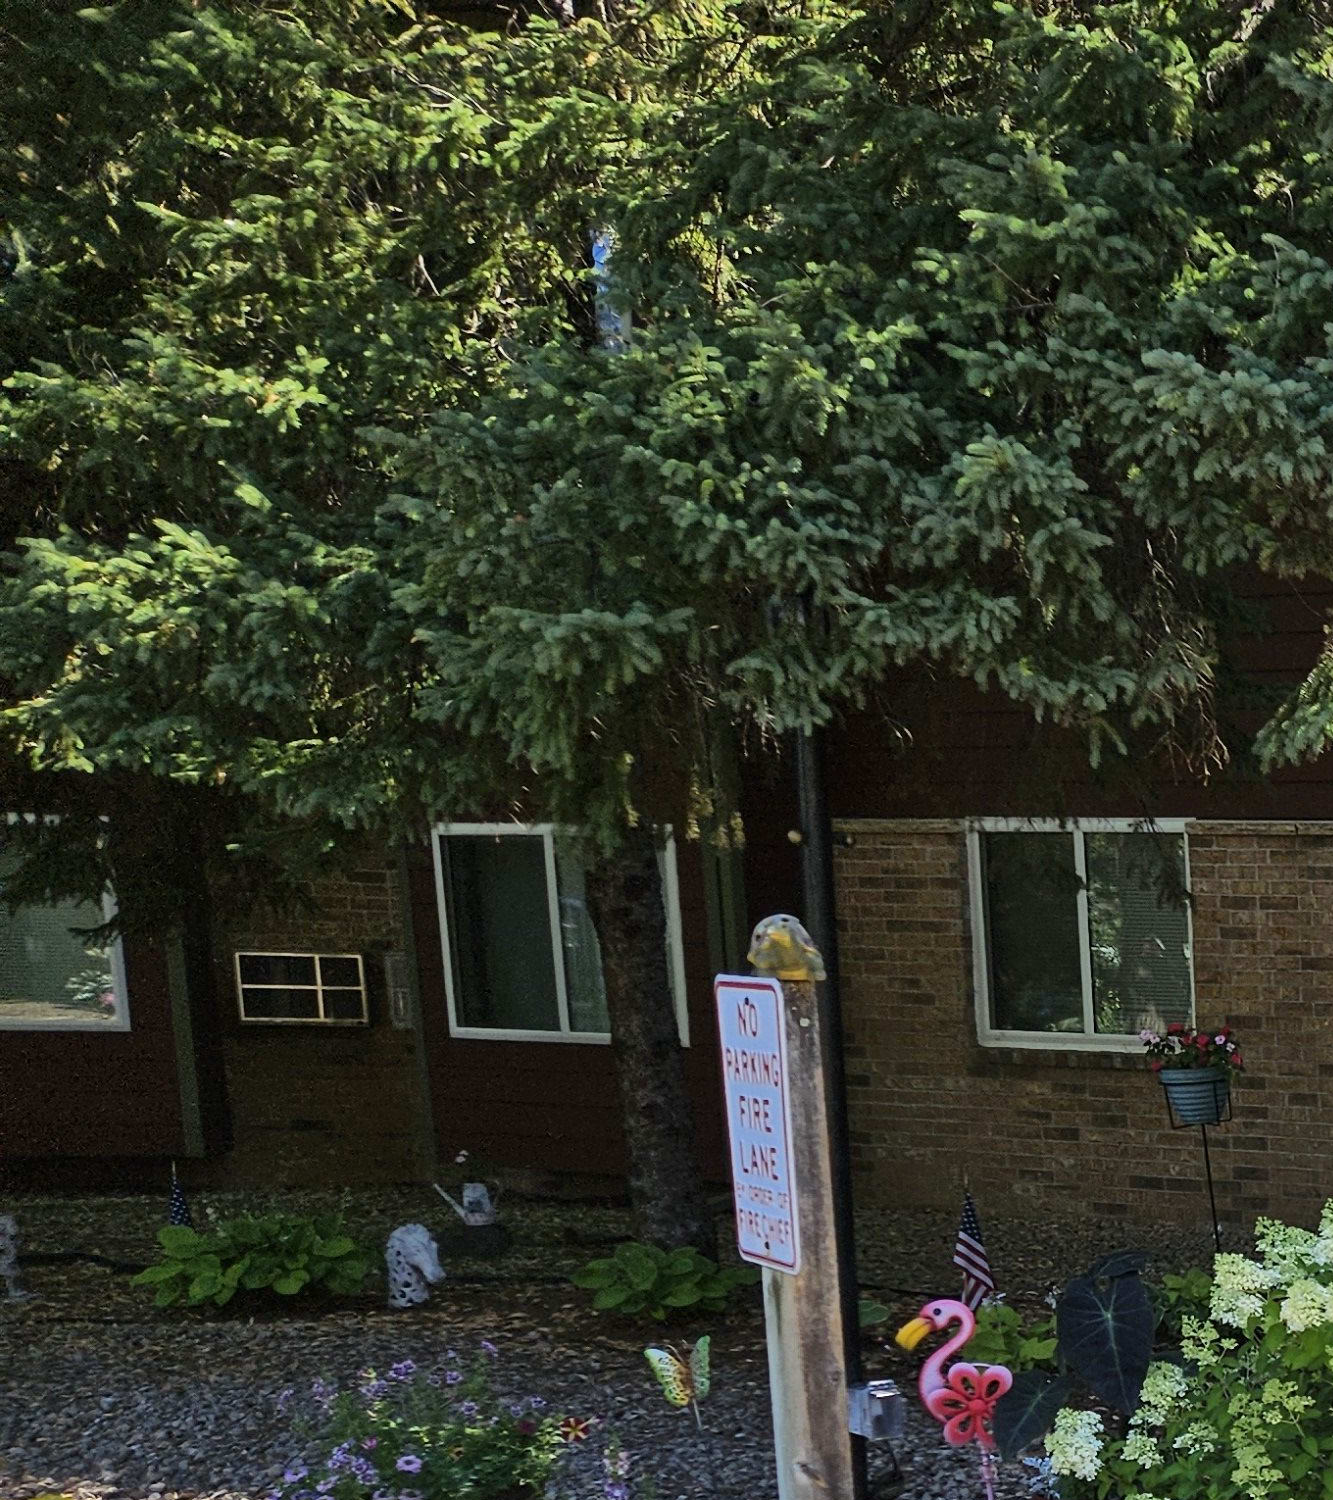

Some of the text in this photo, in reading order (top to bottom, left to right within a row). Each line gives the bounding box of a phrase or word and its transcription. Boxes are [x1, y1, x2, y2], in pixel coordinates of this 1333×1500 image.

[737, 1001, 758, 1037] NO
[725, 1047, 779, 1087] PARKING
[739, 1095, 773, 1133] FIRE
[739, 1140, 779, 1181] LANE
[738, 1207, 790, 1245] FIRE CHIEF
